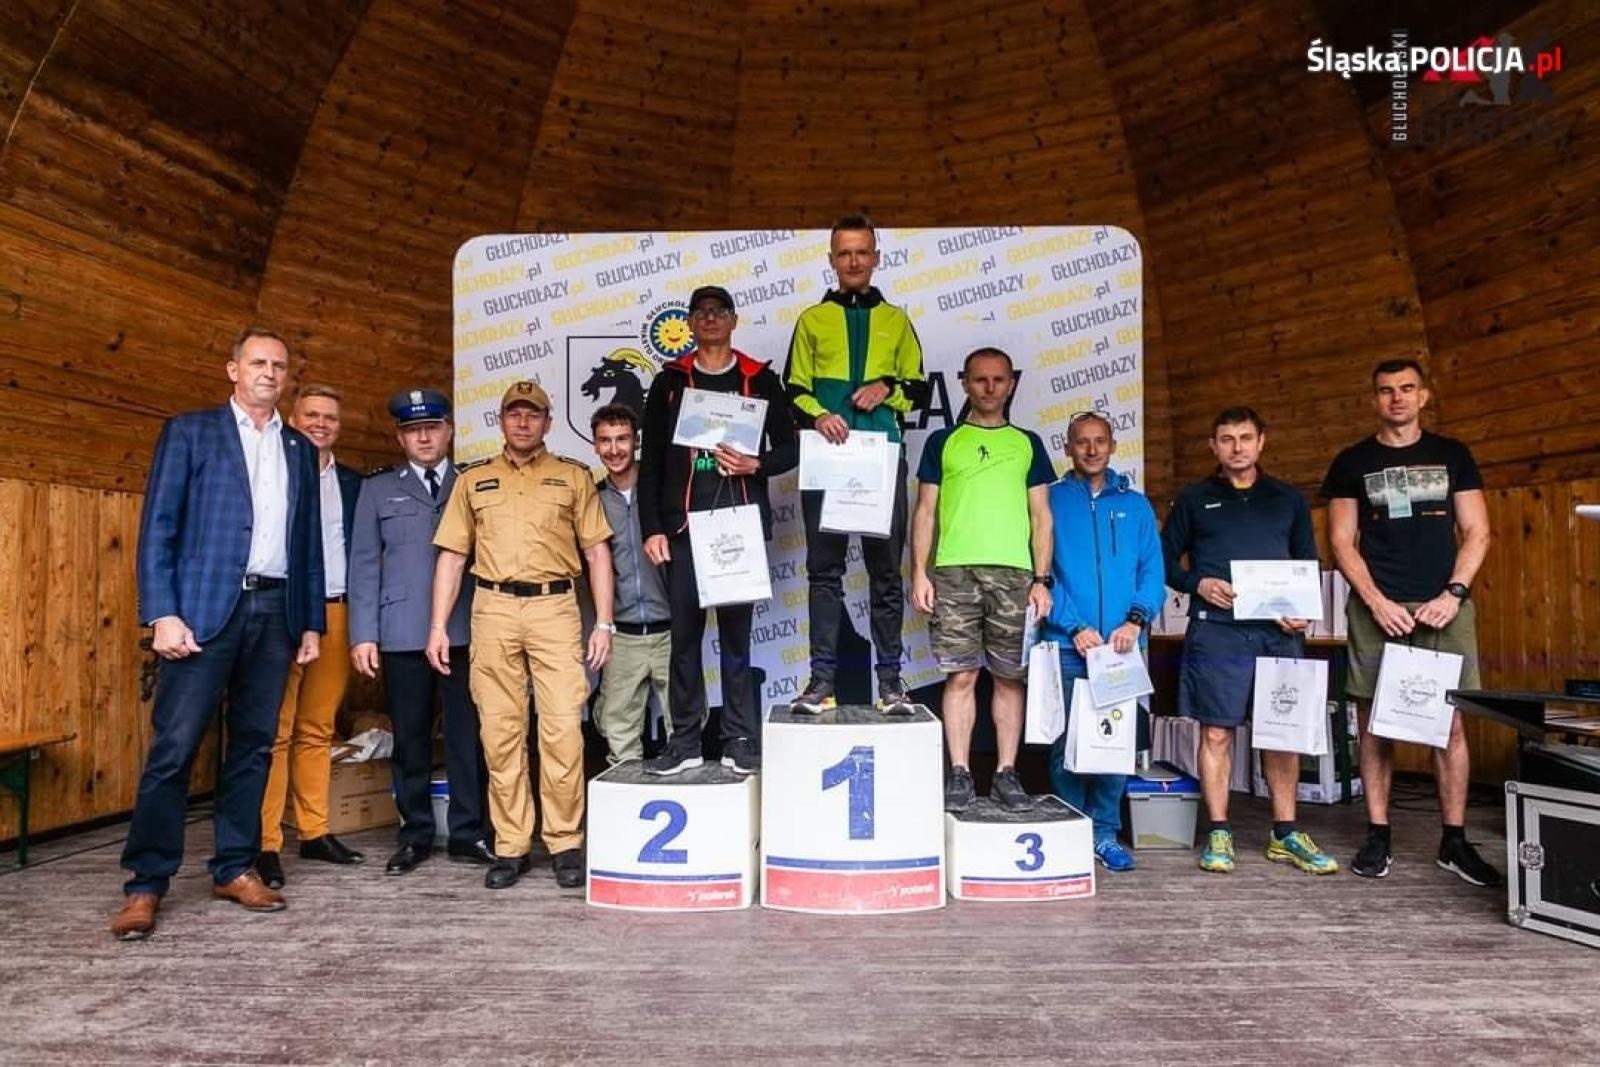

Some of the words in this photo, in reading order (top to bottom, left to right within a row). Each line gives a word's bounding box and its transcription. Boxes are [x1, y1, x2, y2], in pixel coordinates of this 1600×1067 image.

[822, 746, 875, 841] 1
[637, 799, 688, 864] 2
[1015, 832, 1046, 872] 3
